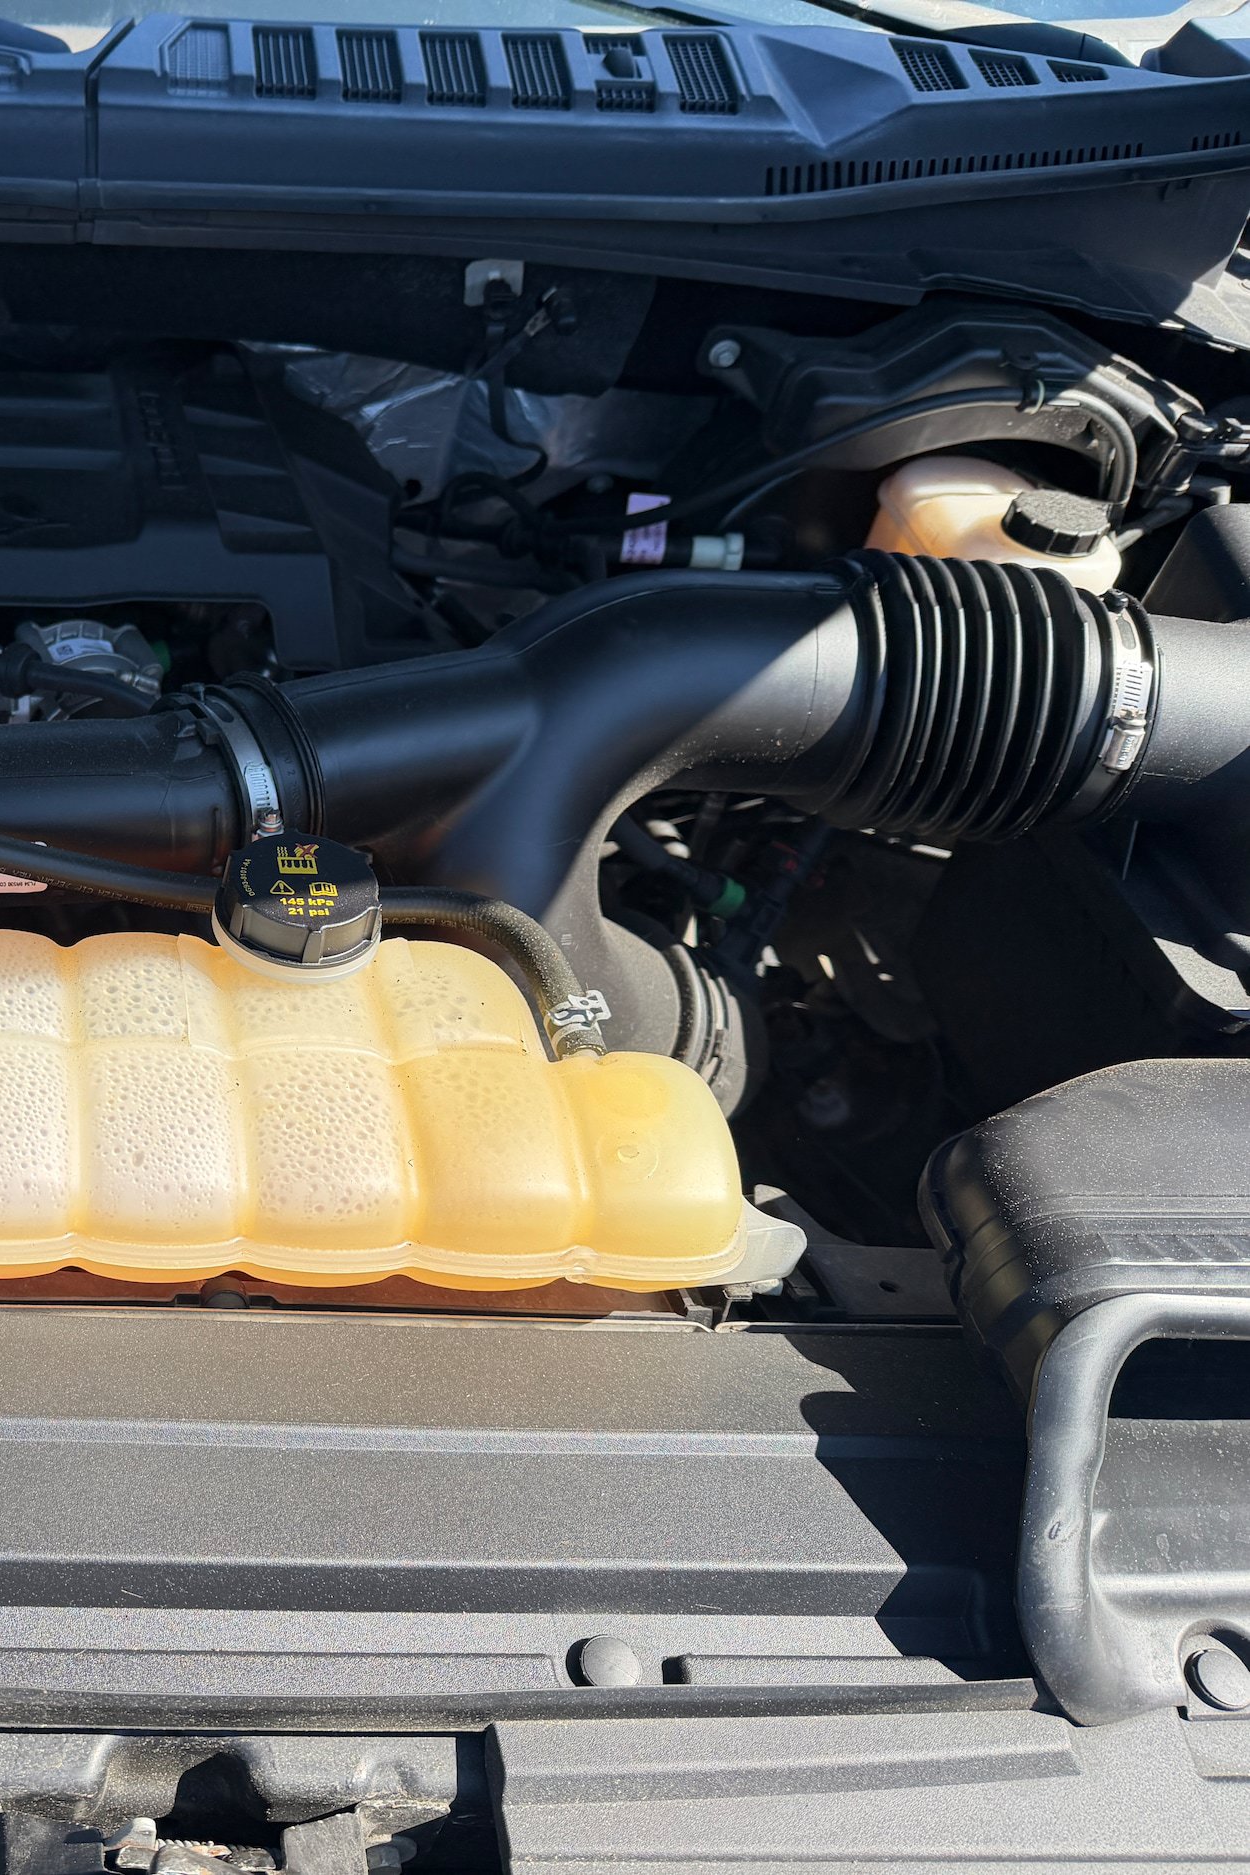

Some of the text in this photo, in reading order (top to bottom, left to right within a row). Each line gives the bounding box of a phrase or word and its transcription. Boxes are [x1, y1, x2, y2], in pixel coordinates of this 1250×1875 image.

[279, 897, 335, 907] 145 kPa
[288, 907, 330, 917] 21 psi
